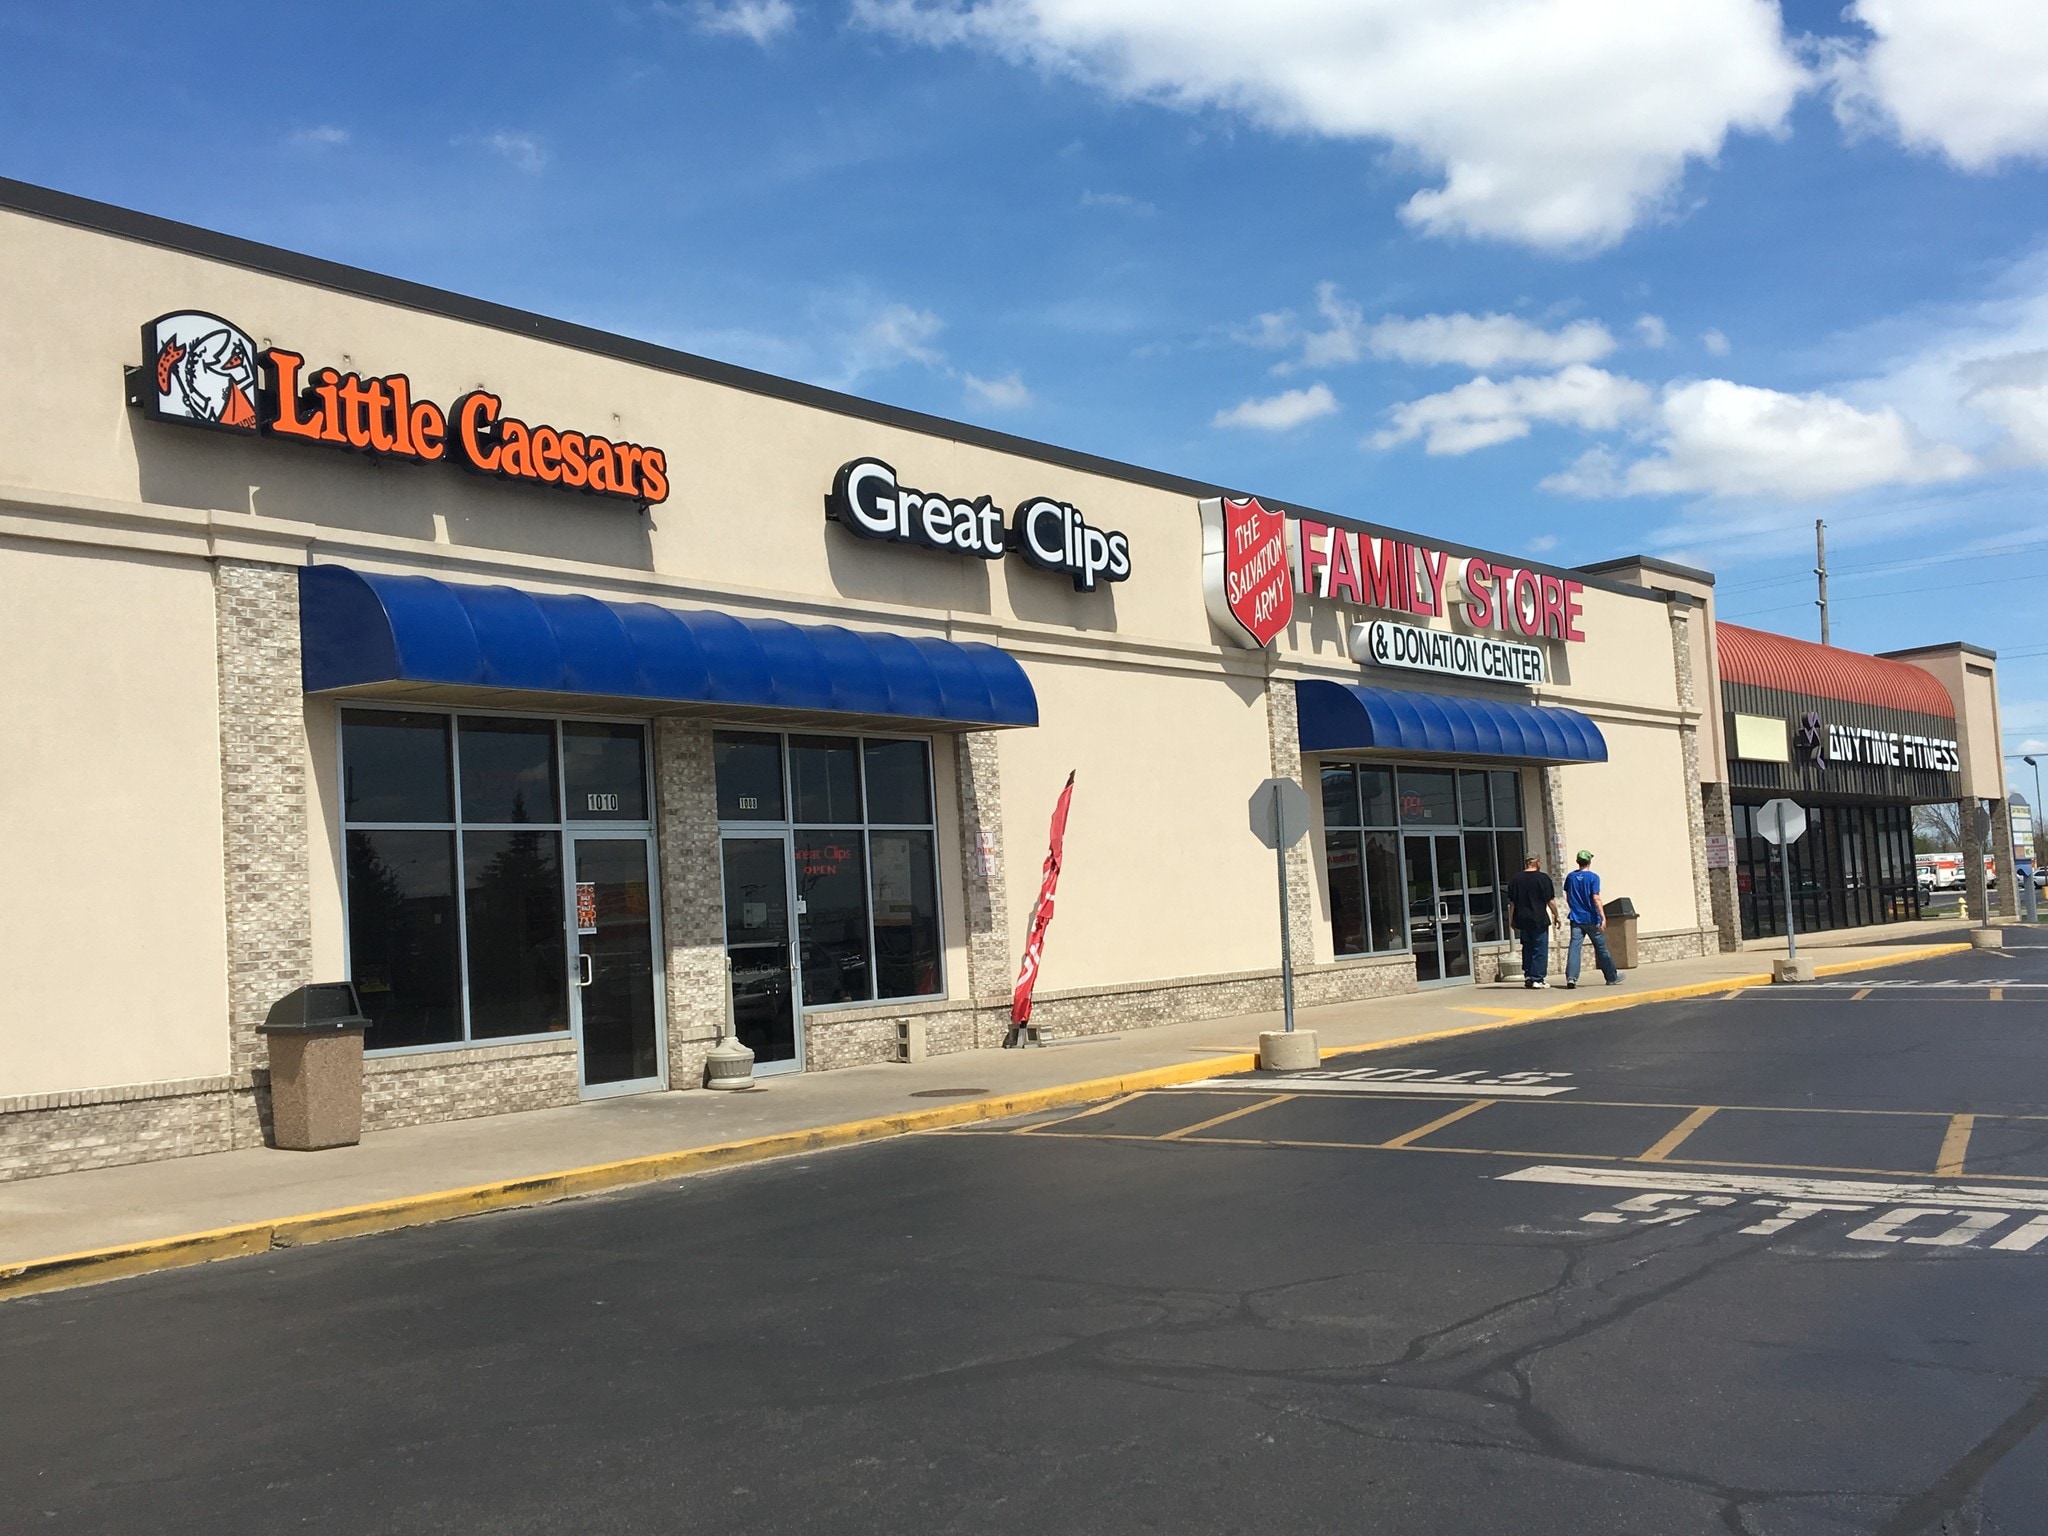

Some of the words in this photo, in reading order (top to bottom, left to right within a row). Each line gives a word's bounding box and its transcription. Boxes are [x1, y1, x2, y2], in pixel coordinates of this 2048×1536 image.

[268, 349, 447, 460] Little
[461, 391, 669, 502] Caesars
[847, 462, 1003, 554] Great
[1026, 501, 1129, 586] Clips
[1235, 514, 1260, 555] THE
[1229, 528, 1283, 604] SALVATION
[1300, 519, 1448, 617] FAMILY
[1466, 557, 1585, 642] STORE
[1254, 569, 1284, 629] ARMY
[1376, 624, 1389, 660] &
[1393, 626, 1478, 672] DONATION
[1481, 642, 1542, 681] CENTER
[1829, 724, 1900, 766] ANYTIME
[1903, 734, 1959, 772] FITNESS
[588, 795, 617, 810] 1010
[803, 865, 836, 875] OPEN
